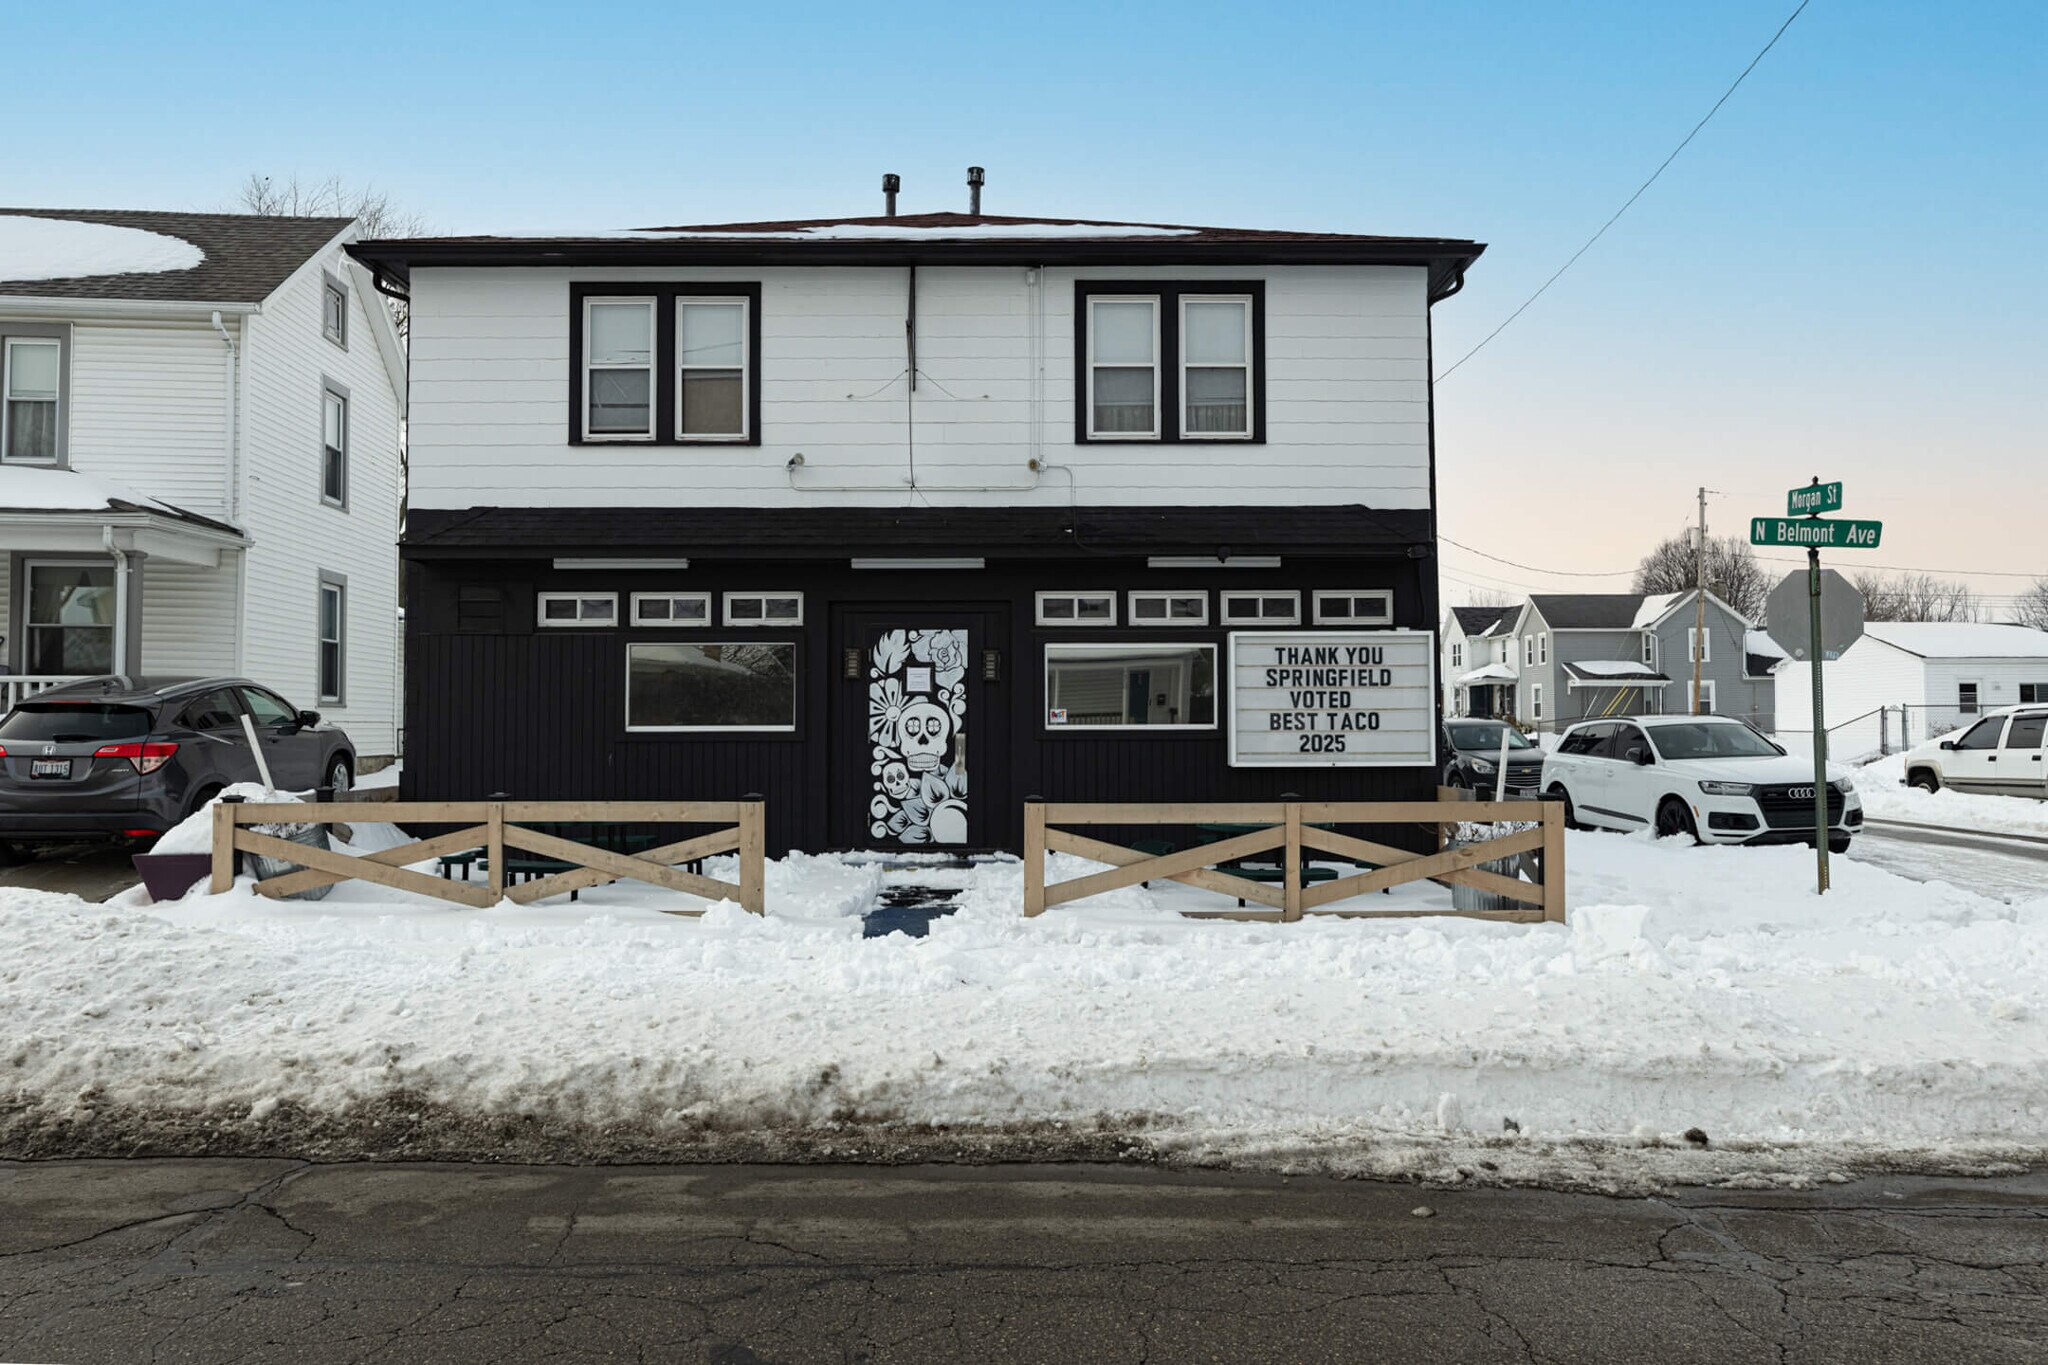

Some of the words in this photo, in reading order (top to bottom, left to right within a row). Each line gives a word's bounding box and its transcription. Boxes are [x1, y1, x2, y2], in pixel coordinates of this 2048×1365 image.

[1791, 490, 1821, 512] Morgan
[1827, 485, 1837, 503] St
[1755, 521, 1766, 541] N
[1777, 521, 1835, 543] Belmont
[1845, 524, 1876, 544] Ave
[1275, 647, 1339, 665] THANK
[1345, 647, 1383, 665] YOU
[1266, 669, 1391, 687] SPRINGFIELD
[1290, 690, 1351, 708] VOTED
[1270, 712, 1318, 730] BEST
[1327, 712, 1380, 730] TACO
[1299, 734, 1345, 752] 2025
